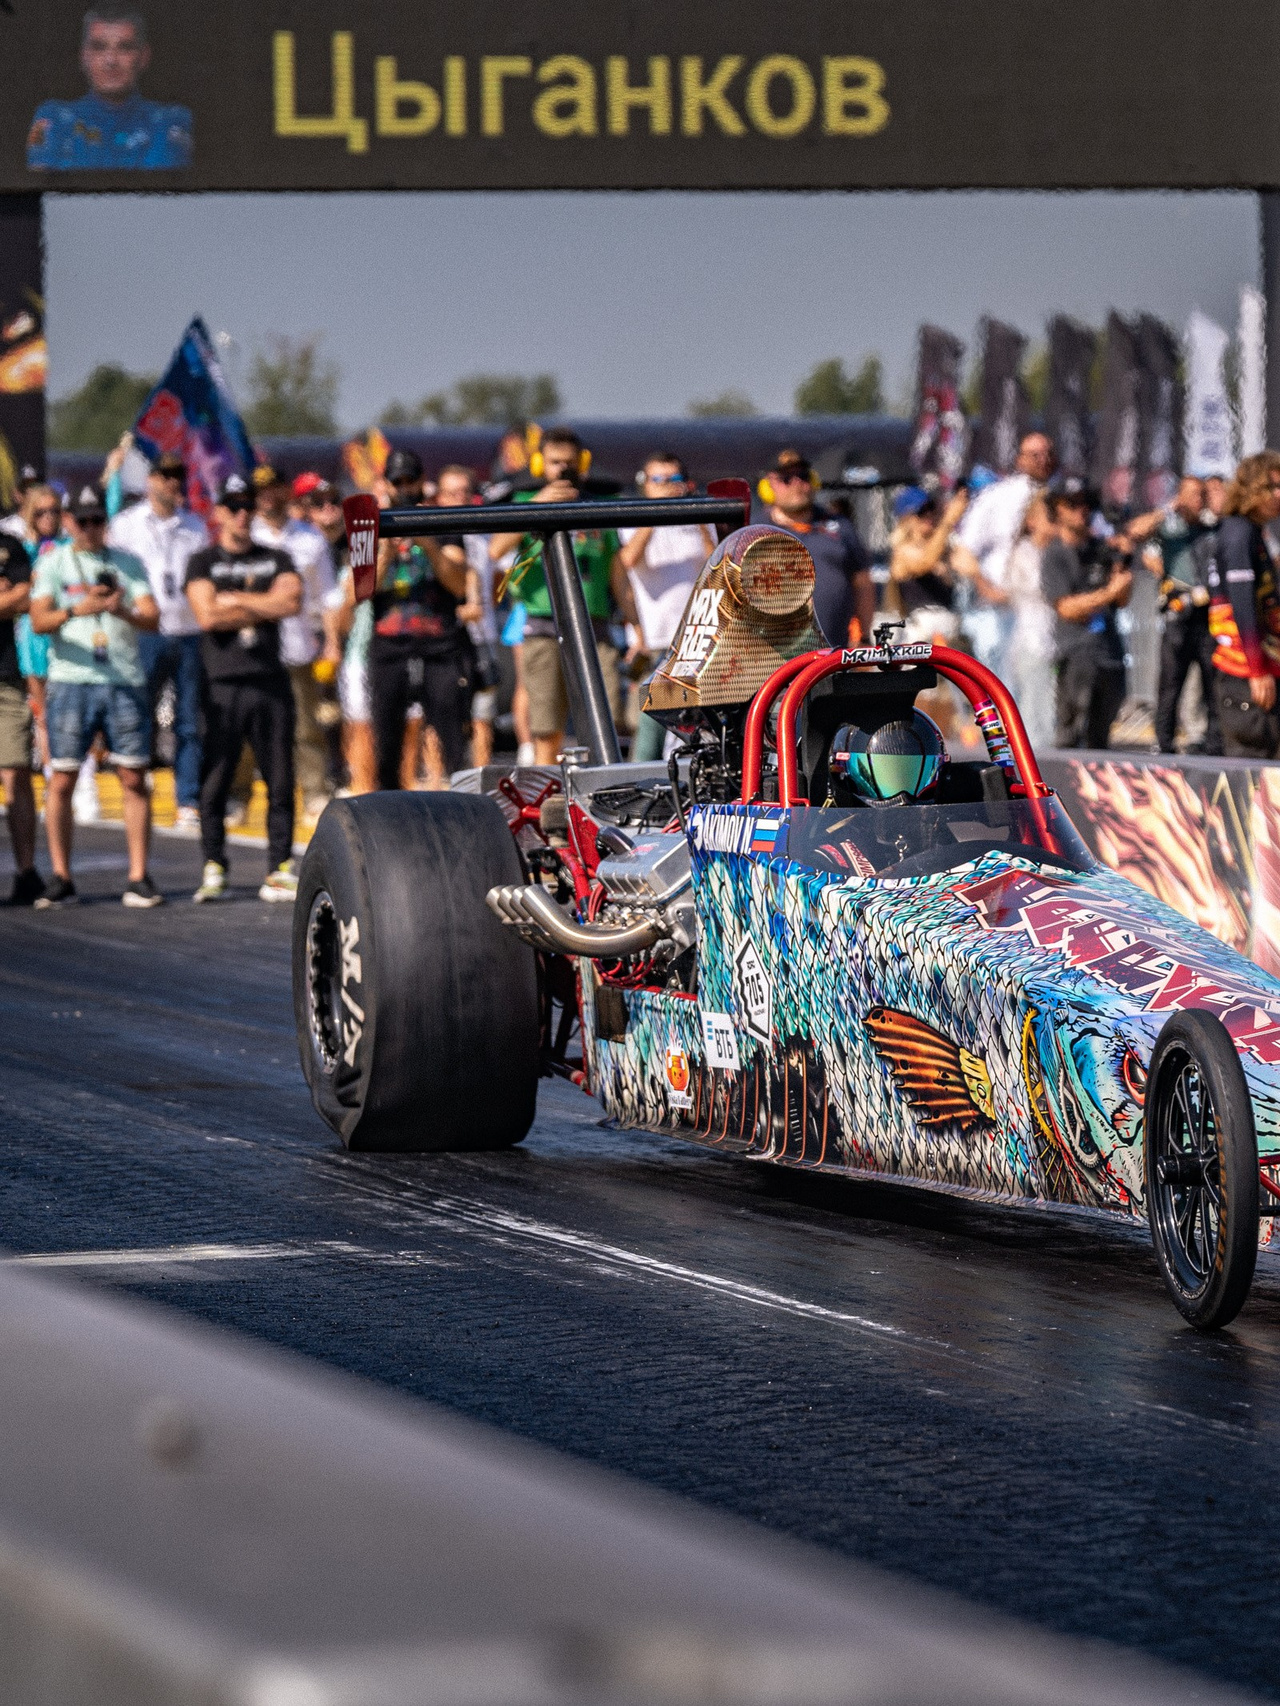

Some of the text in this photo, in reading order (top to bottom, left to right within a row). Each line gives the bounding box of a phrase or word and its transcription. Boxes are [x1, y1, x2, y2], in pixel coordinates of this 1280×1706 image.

[273, 29, 890, 153] Цыганков
[687, 588, 724, 626] MAX
[677, 625, 717, 660] RIDE
[704, 813, 745, 854] AKIMOV
[745, 973, 764, 1007] 705
[714, 1028, 734, 1060] ВТБ
